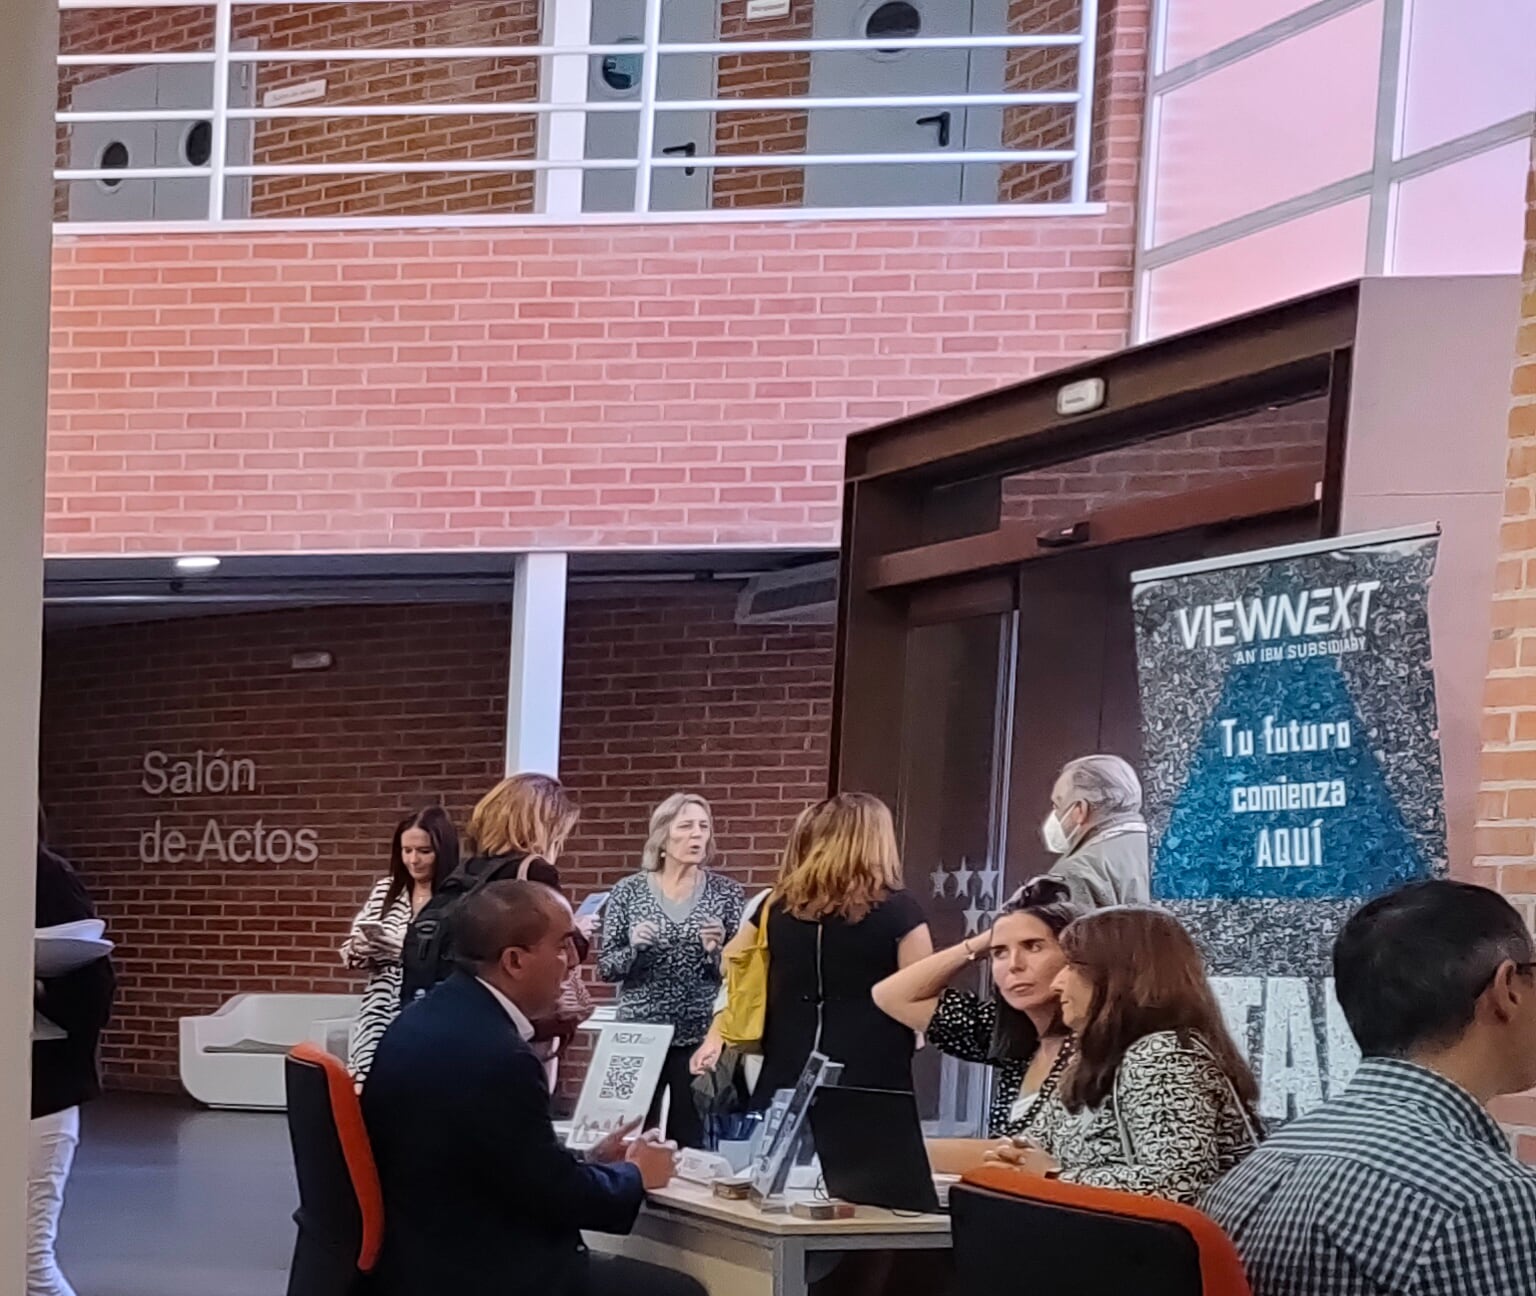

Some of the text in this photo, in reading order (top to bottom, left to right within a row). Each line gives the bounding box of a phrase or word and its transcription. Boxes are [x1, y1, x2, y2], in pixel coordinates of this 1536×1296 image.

[1180, 581, 1381, 649] VIEWNEXT
[1236, 650, 1256, 665] AN
[1260, 646, 1283, 662] IBM
[1221, 715, 1351, 757] Tu futuro
[142, 748, 256, 794] Salón
[1232, 775, 1346, 813] comienza
[140, 818, 319, 863] de Actos
[1256, 818, 1324, 867] AQUÍ
